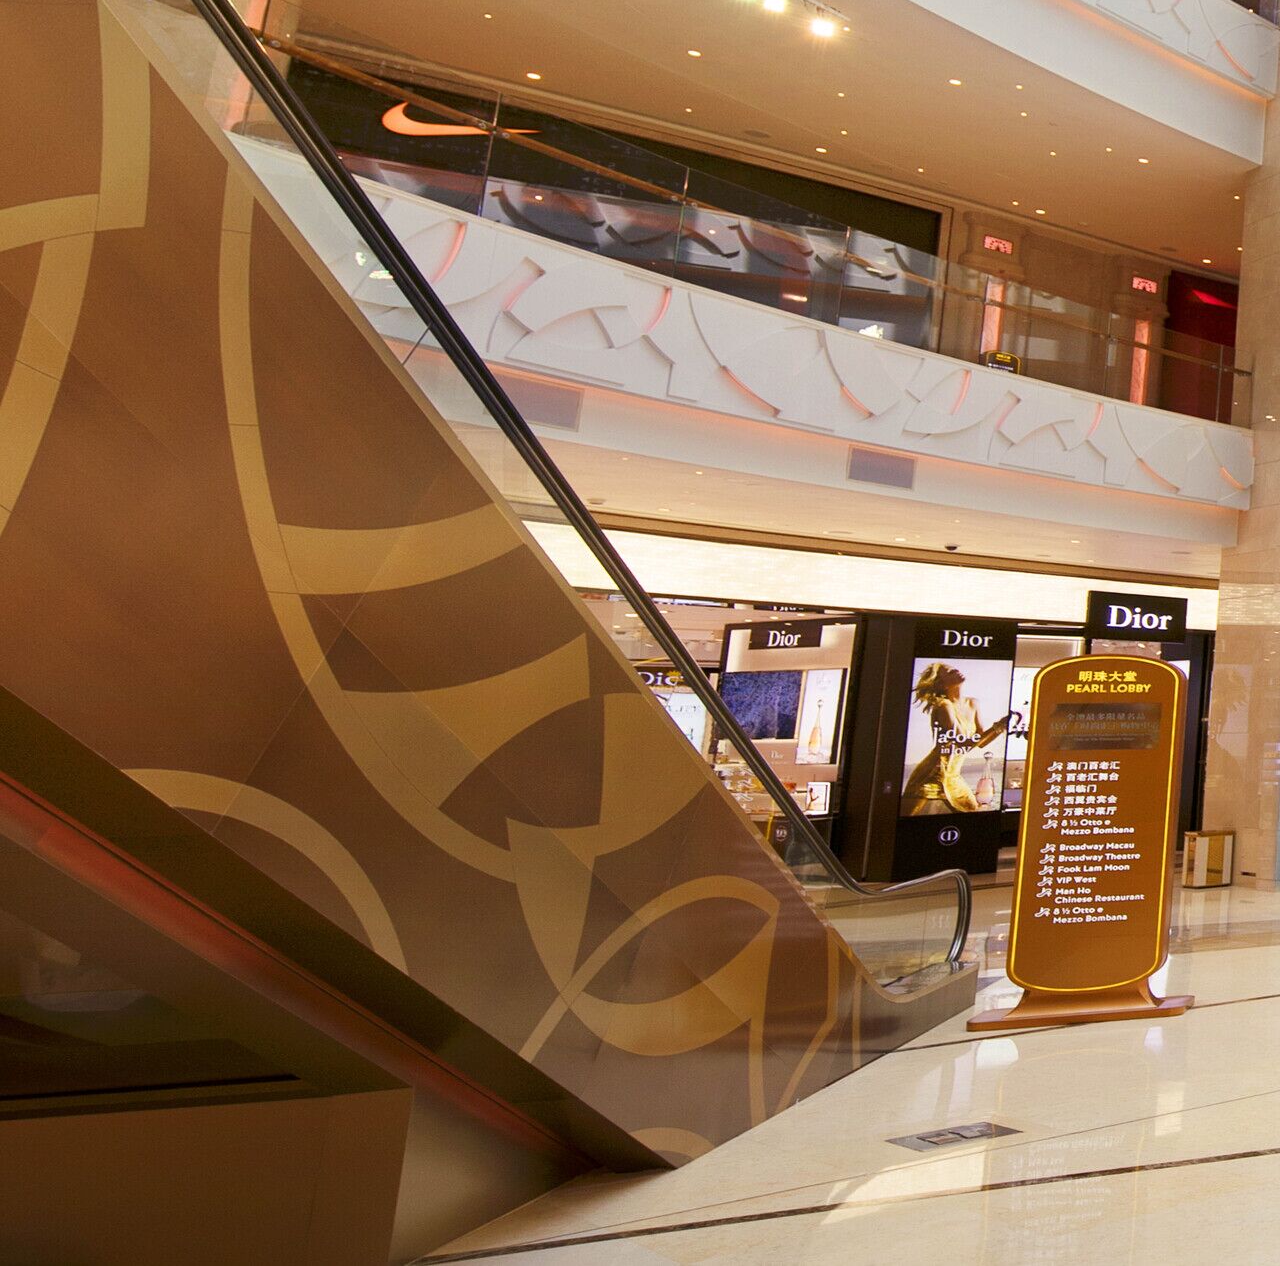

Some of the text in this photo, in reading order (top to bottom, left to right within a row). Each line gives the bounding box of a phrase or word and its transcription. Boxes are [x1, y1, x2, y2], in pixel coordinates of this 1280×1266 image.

[1107, 605, 1173, 630] Dior
[767, 630, 802, 647] Dior
[942, 629, 994, 649] Dior
[1078, 670, 1138, 683] 明珠大堂
[1066, 683, 1152, 694] PEARL LOBBY
[941, 745, 950, 754] in
[1066, 761, 1121, 770] 澳门百老汇
[1065, 784, 1097, 793] 福临门
[1060, 826, 1135, 835] Mezzo Bombana
[1059, 842, 1135, 852] Broadway Macau
[1058, 853, 1141, 863] Broadway Theatre
[1056, 876, 1072, 884] VIP
[1054, 894, 1145, 904] Chinese Restaurant
